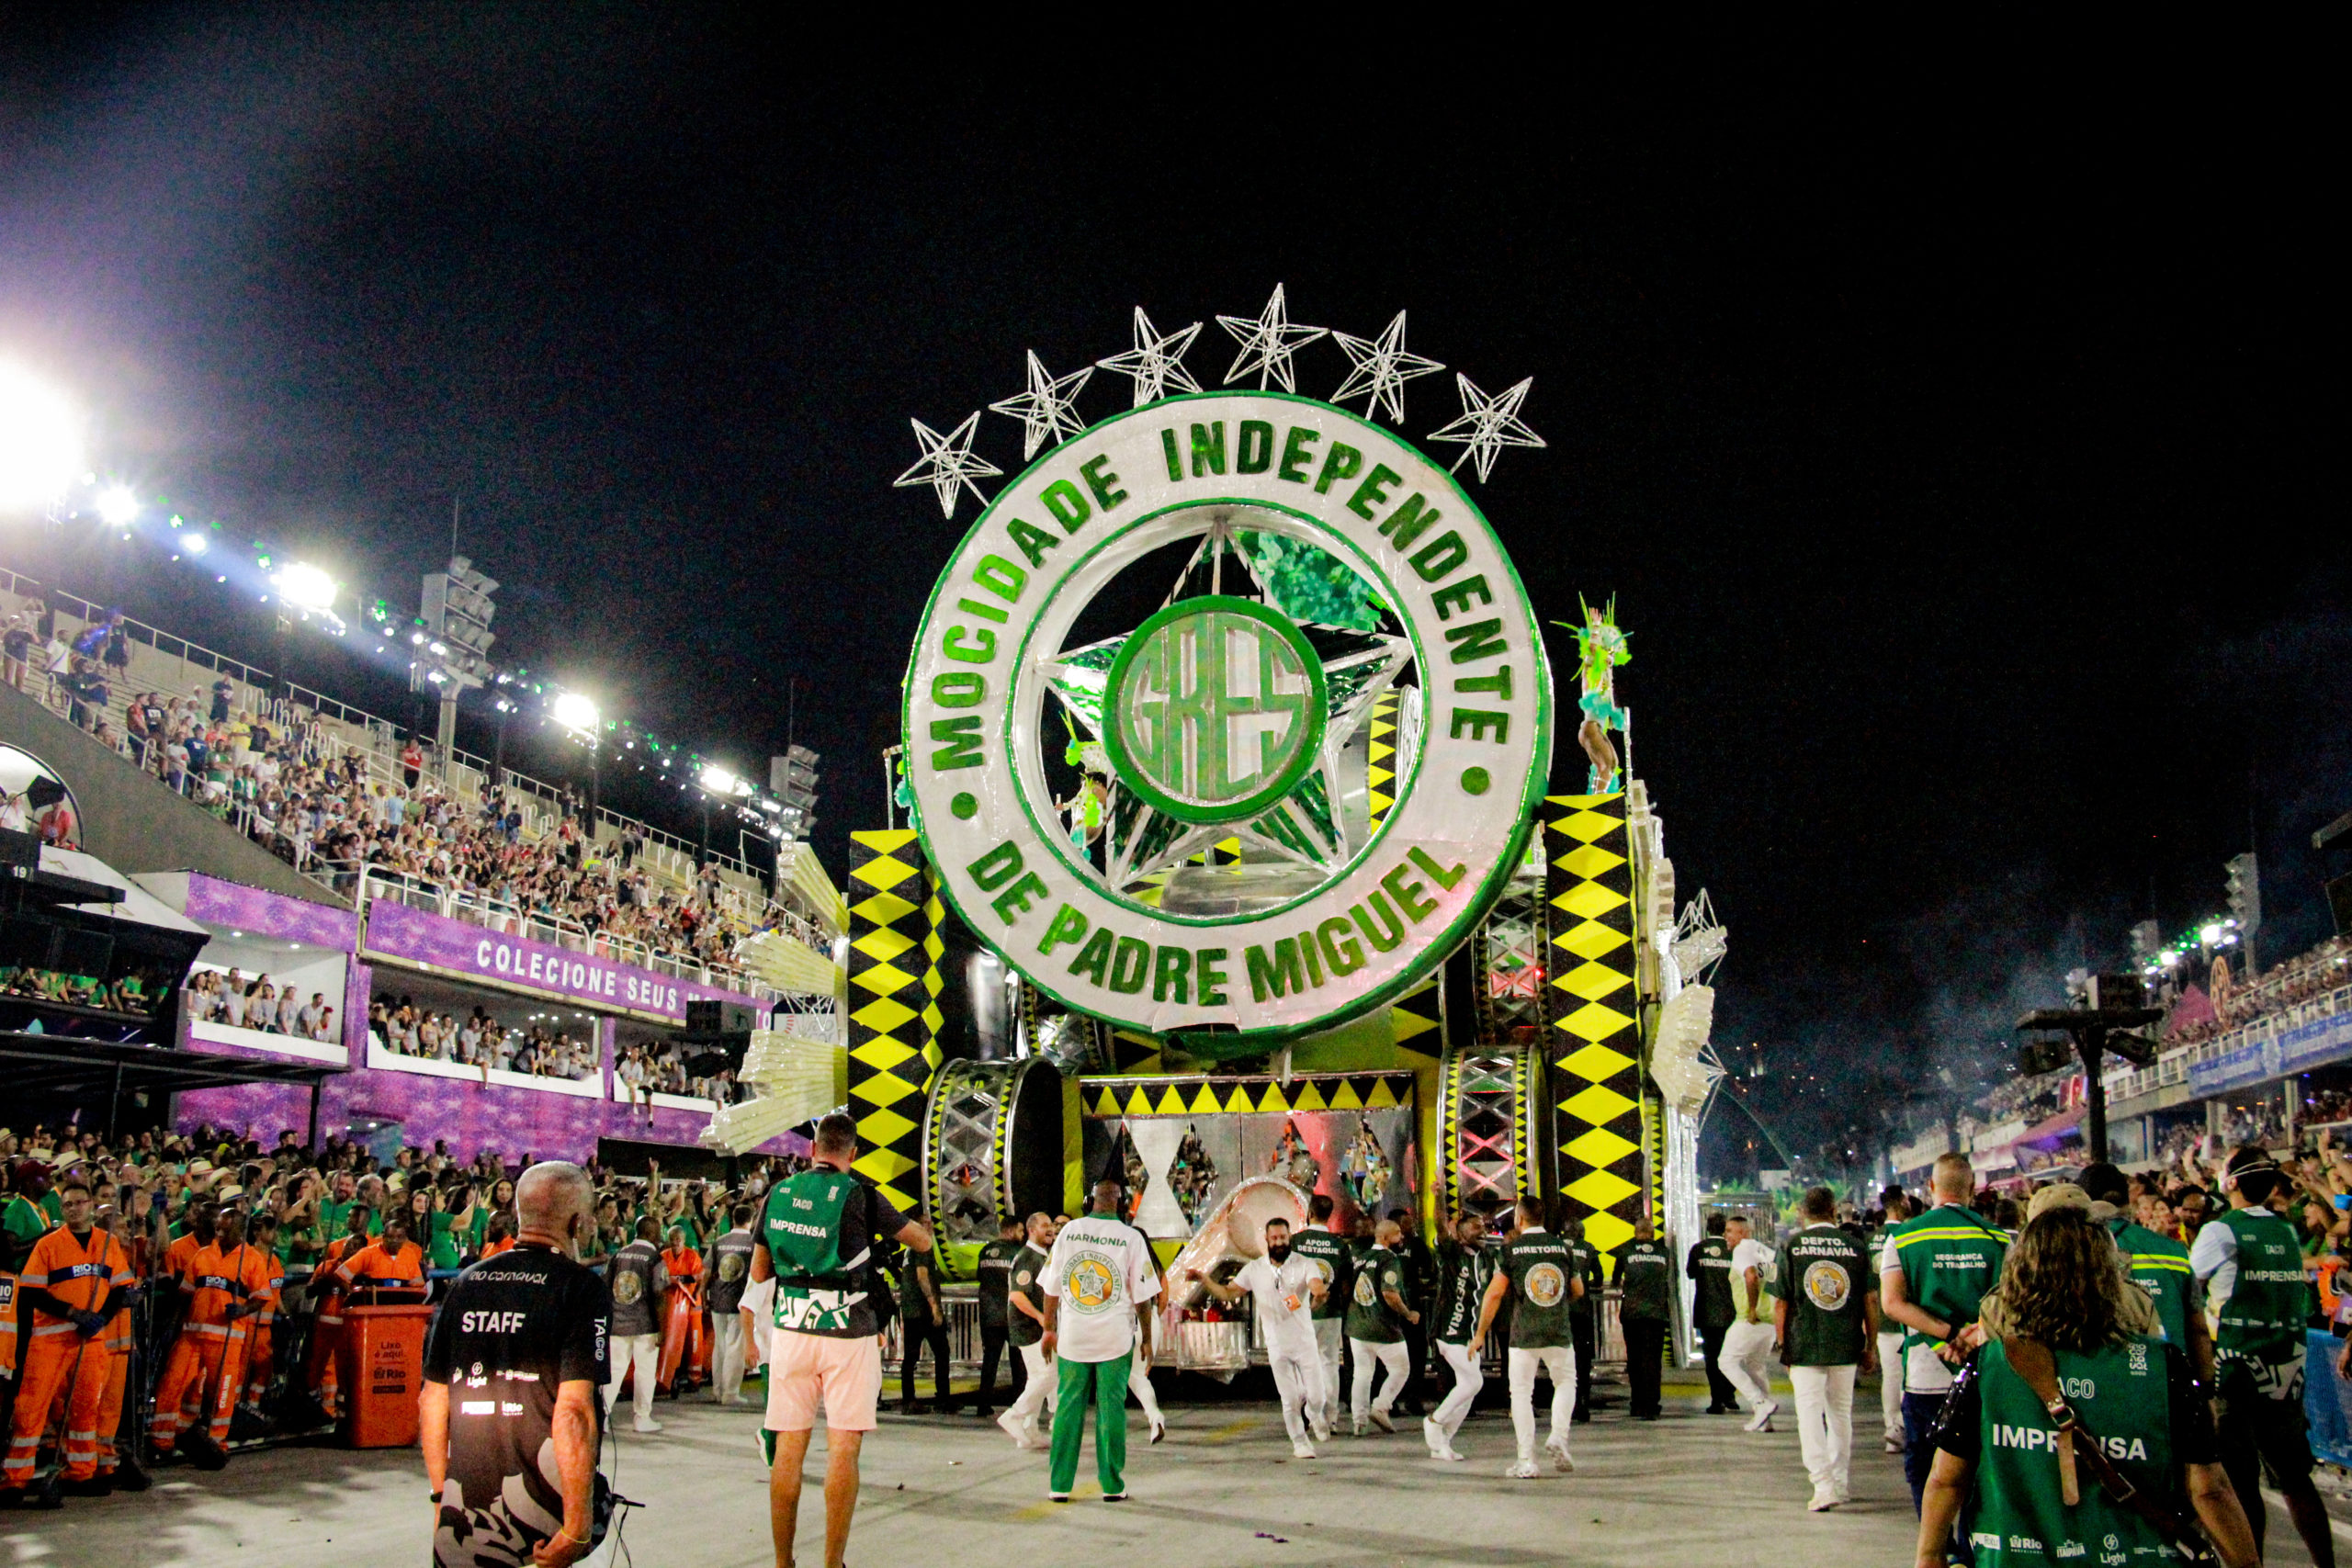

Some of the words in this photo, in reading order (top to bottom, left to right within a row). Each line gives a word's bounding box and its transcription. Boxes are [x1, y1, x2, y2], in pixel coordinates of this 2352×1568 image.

[930, 453, 1128, 772] MOCIDADE
[1161, 419, 1512, 745] INDEPENDENTE
[967, 840, 1048, 926] DE
[1036, 903, 1228, 1007] PADRE
[1244, 845, 1467, 1004] MIGUEL
[477, 940, 616, 997] COLECIONE
[628, 976, 678, 1011] SEUS
[792, 1197, 813, 1211] TACO
[770, 1218, 827, 1239] IMPRENSA
[1066, 1233, 1127, 1247] HARMONIA
[1305, 1238, 1331, 1247] APOIO
[1801, 1236, 1846, 1247] DEPTO.
[1297, 1245, 1340, 1256] DESTAQUE
[1511, 1245, 1567, 1256] DIRETORIA
[1792, 1246, 1858, 1258] CARNAVAL
[2264, 1244, 2286, 1256] TACO
[1934, 1253, 1984, 1262] SEGURANÇA
[73, 1263, 92, 1274] RIO
[1945, 1261, 1987, 1269] TRABALHO
[461, 1311, 526, 1334] STAFF
[594, 1316, 607, 1361] TACO
[1992, 1424, 2148, 1461] IMPRSA
[2022, 1538, 2043, 1551] Rio
[2099, 1551, 2127, 1567] Light
